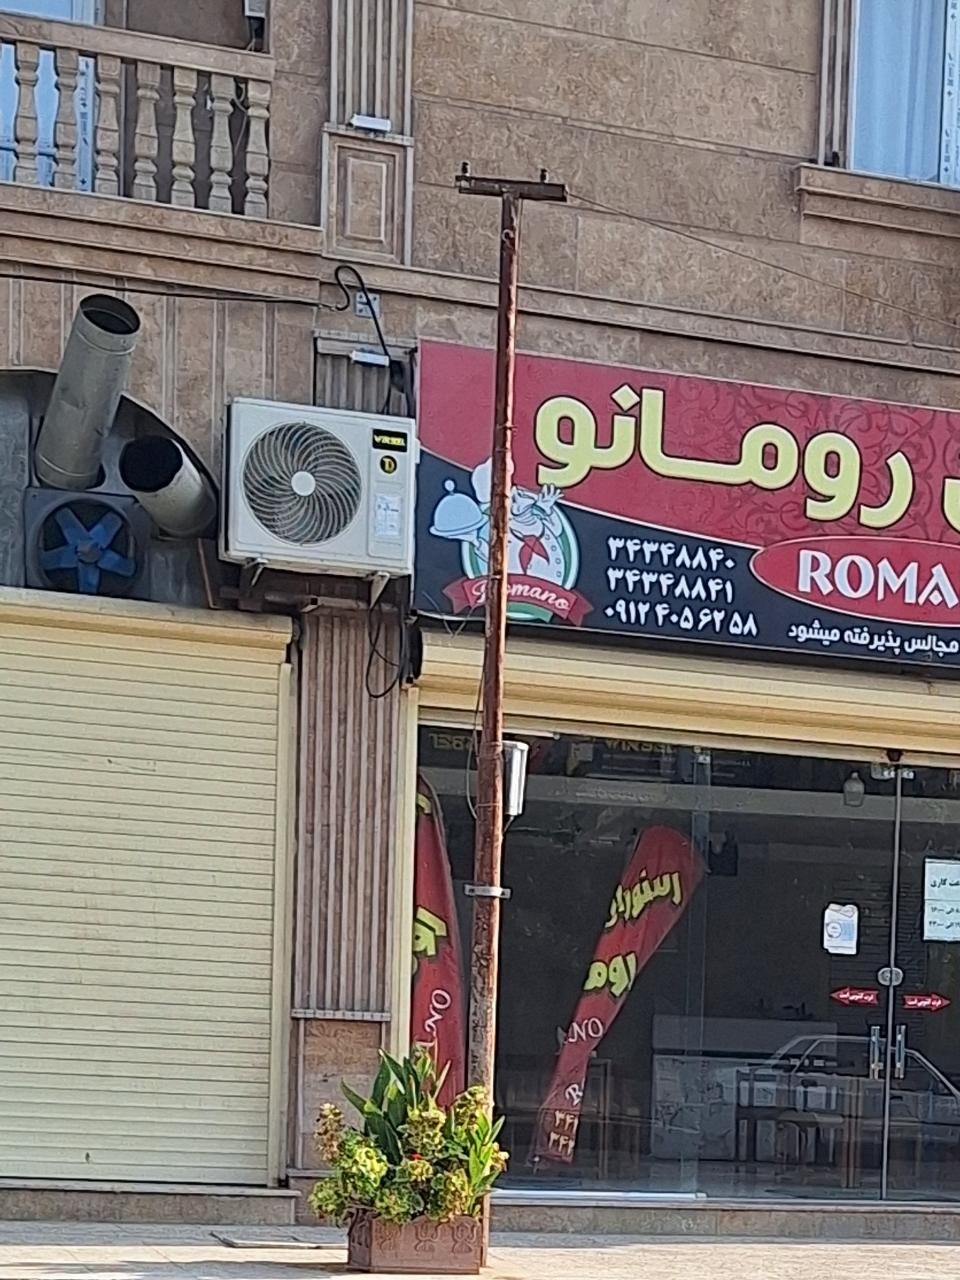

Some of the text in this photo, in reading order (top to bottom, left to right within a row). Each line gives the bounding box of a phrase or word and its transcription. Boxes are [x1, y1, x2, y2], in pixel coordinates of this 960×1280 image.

[536, 383, 914, 529] رومانو
[607, 537, 735, 571] ۳۴۳۴۸۸۴۰
[606, 567, 733, 603] ۳۴۳۴۸۸۴۱
[788, 619, 841, 645] میشود
[844, 627, 901, 655] پذیرفته
[904, 635, 959, 657] مجالس
